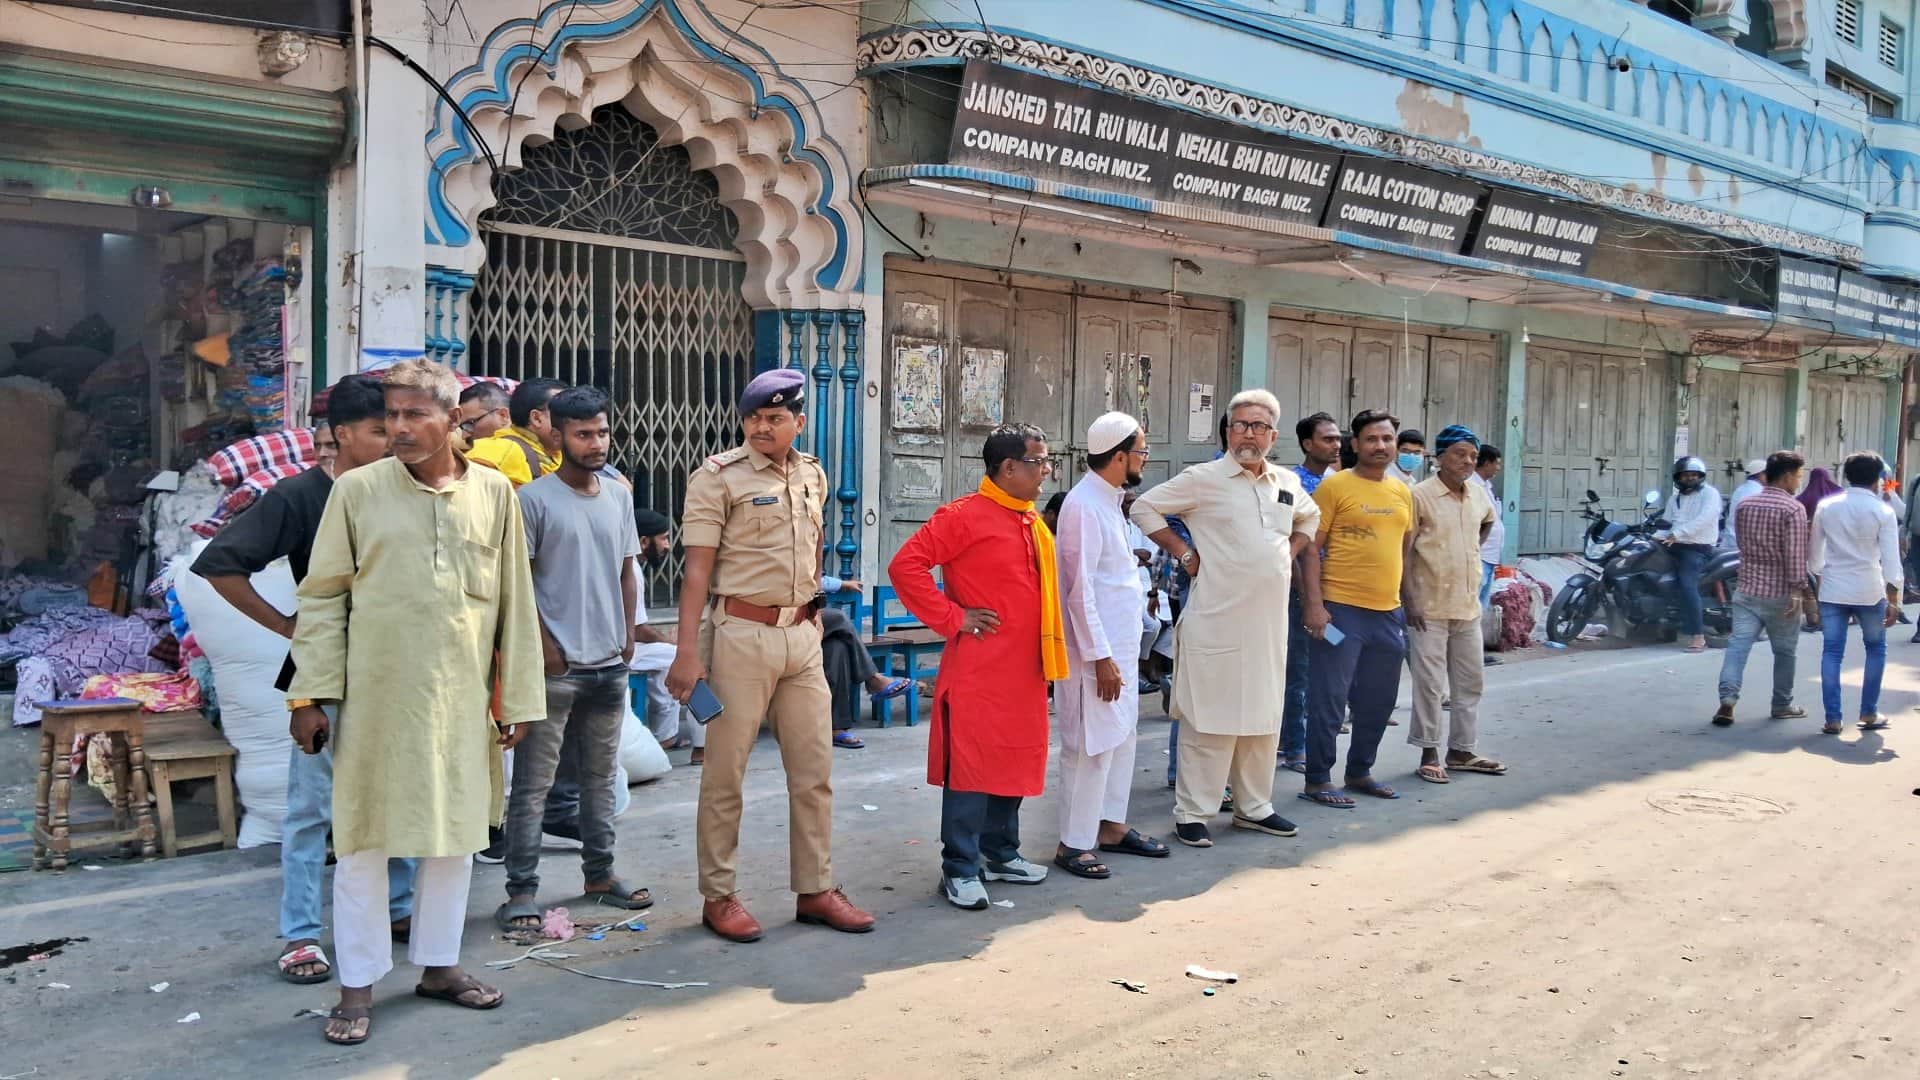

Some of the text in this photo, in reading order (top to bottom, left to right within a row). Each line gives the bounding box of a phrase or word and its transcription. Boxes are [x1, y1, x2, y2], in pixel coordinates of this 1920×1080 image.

[964, 81, 1169, 153] JAMSHED TATA RUI WALA
[963, 127, 1152, 183] COMPANY BAGH MUZ.
[1175, 132, 1331, 187] NEHAL BHI RUI WALE
[1173, 172, 1312, 214] COMPANY BAGH MUZ.
[1341, 168, 1475, 217] RAJA COTTON SHOP
[1340, 203, 1456, 241] COMPANY BAGH MUZ.
[1488, 204, 1598, 245] MUNNA RUI DUKAN
[1485, 236, 1534, 257] COMPANY
[1533, 245, 1560, 262] BAGH
